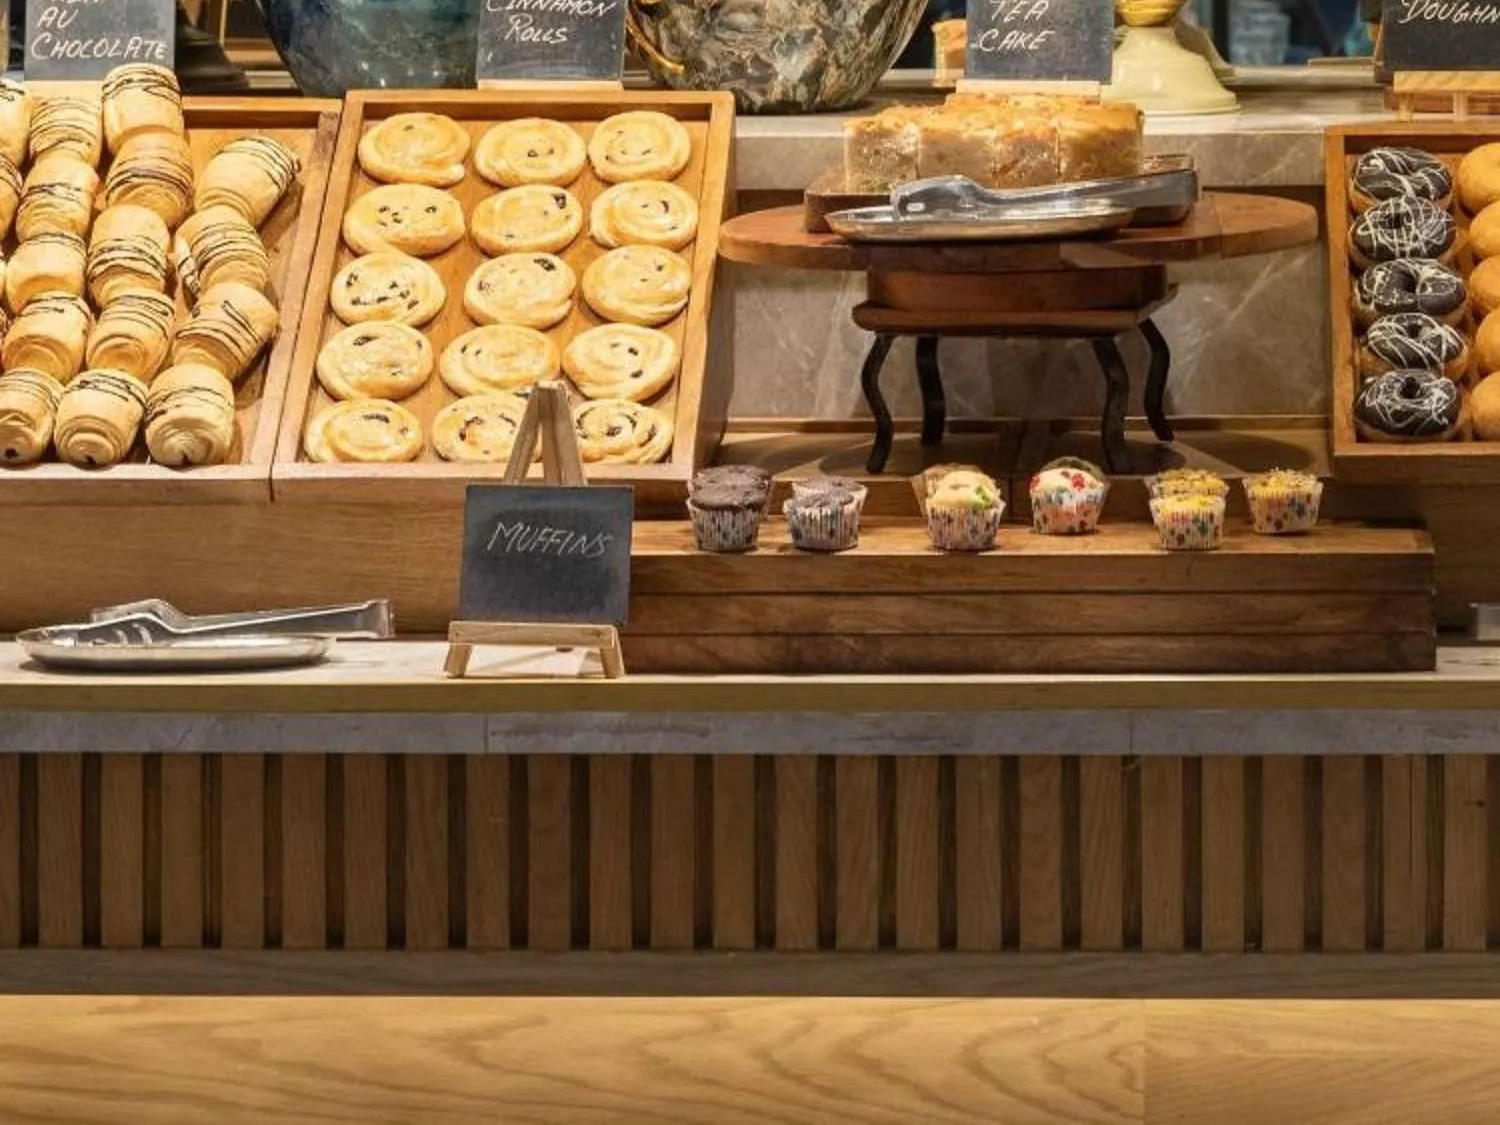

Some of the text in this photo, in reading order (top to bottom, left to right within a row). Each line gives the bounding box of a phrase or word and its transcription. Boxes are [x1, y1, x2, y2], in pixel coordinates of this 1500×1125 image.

[37, 6, 79, 29] AU
[504, 13, 568, 43] ROLLS
[31, 32, 168, 60] CHOCOLATE
[979, 28, 1056, 52] CAKE
[487, 522, 613, 558] MUFFINS
